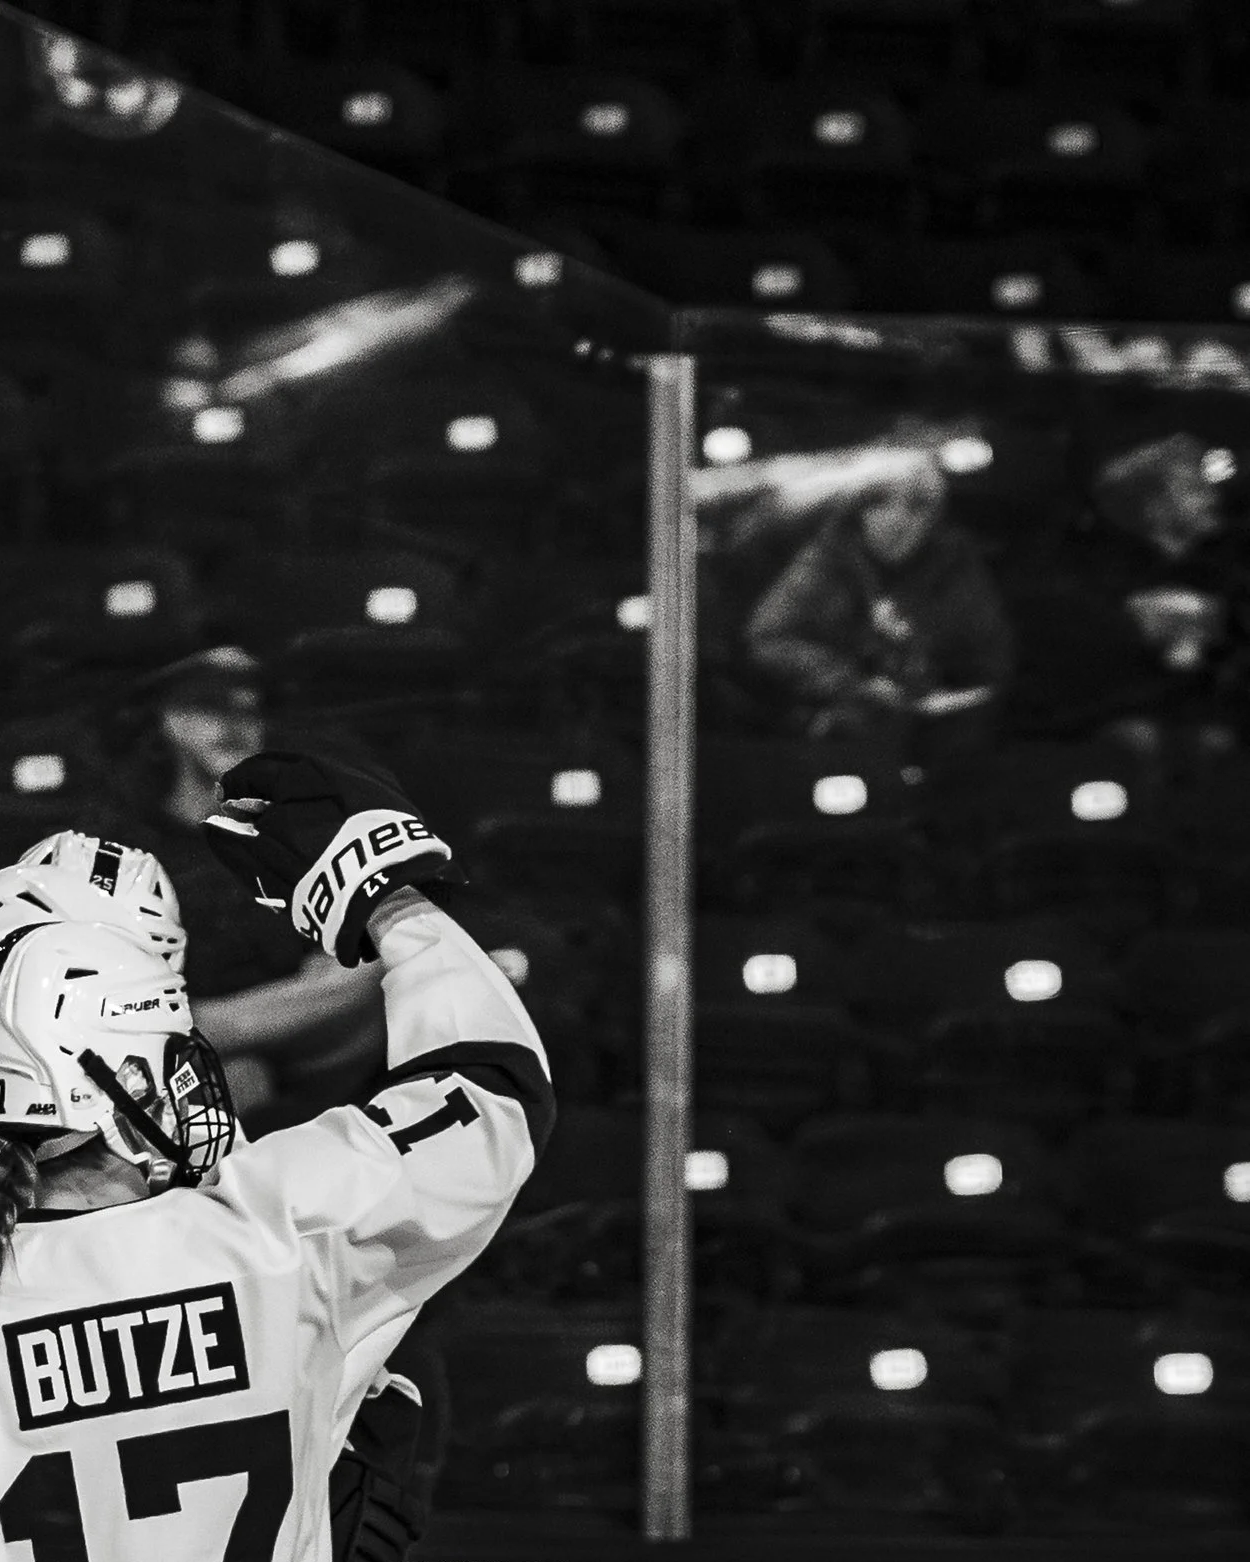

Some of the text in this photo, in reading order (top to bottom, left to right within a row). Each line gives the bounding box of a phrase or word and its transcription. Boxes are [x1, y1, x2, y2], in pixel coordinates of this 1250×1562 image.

[91, 874, 114, 891] 25
[300, 817, 435, 943] BAUER
[362, 870, 390, 898] 17
[18, 1296, 237, 1417] BUTZE
